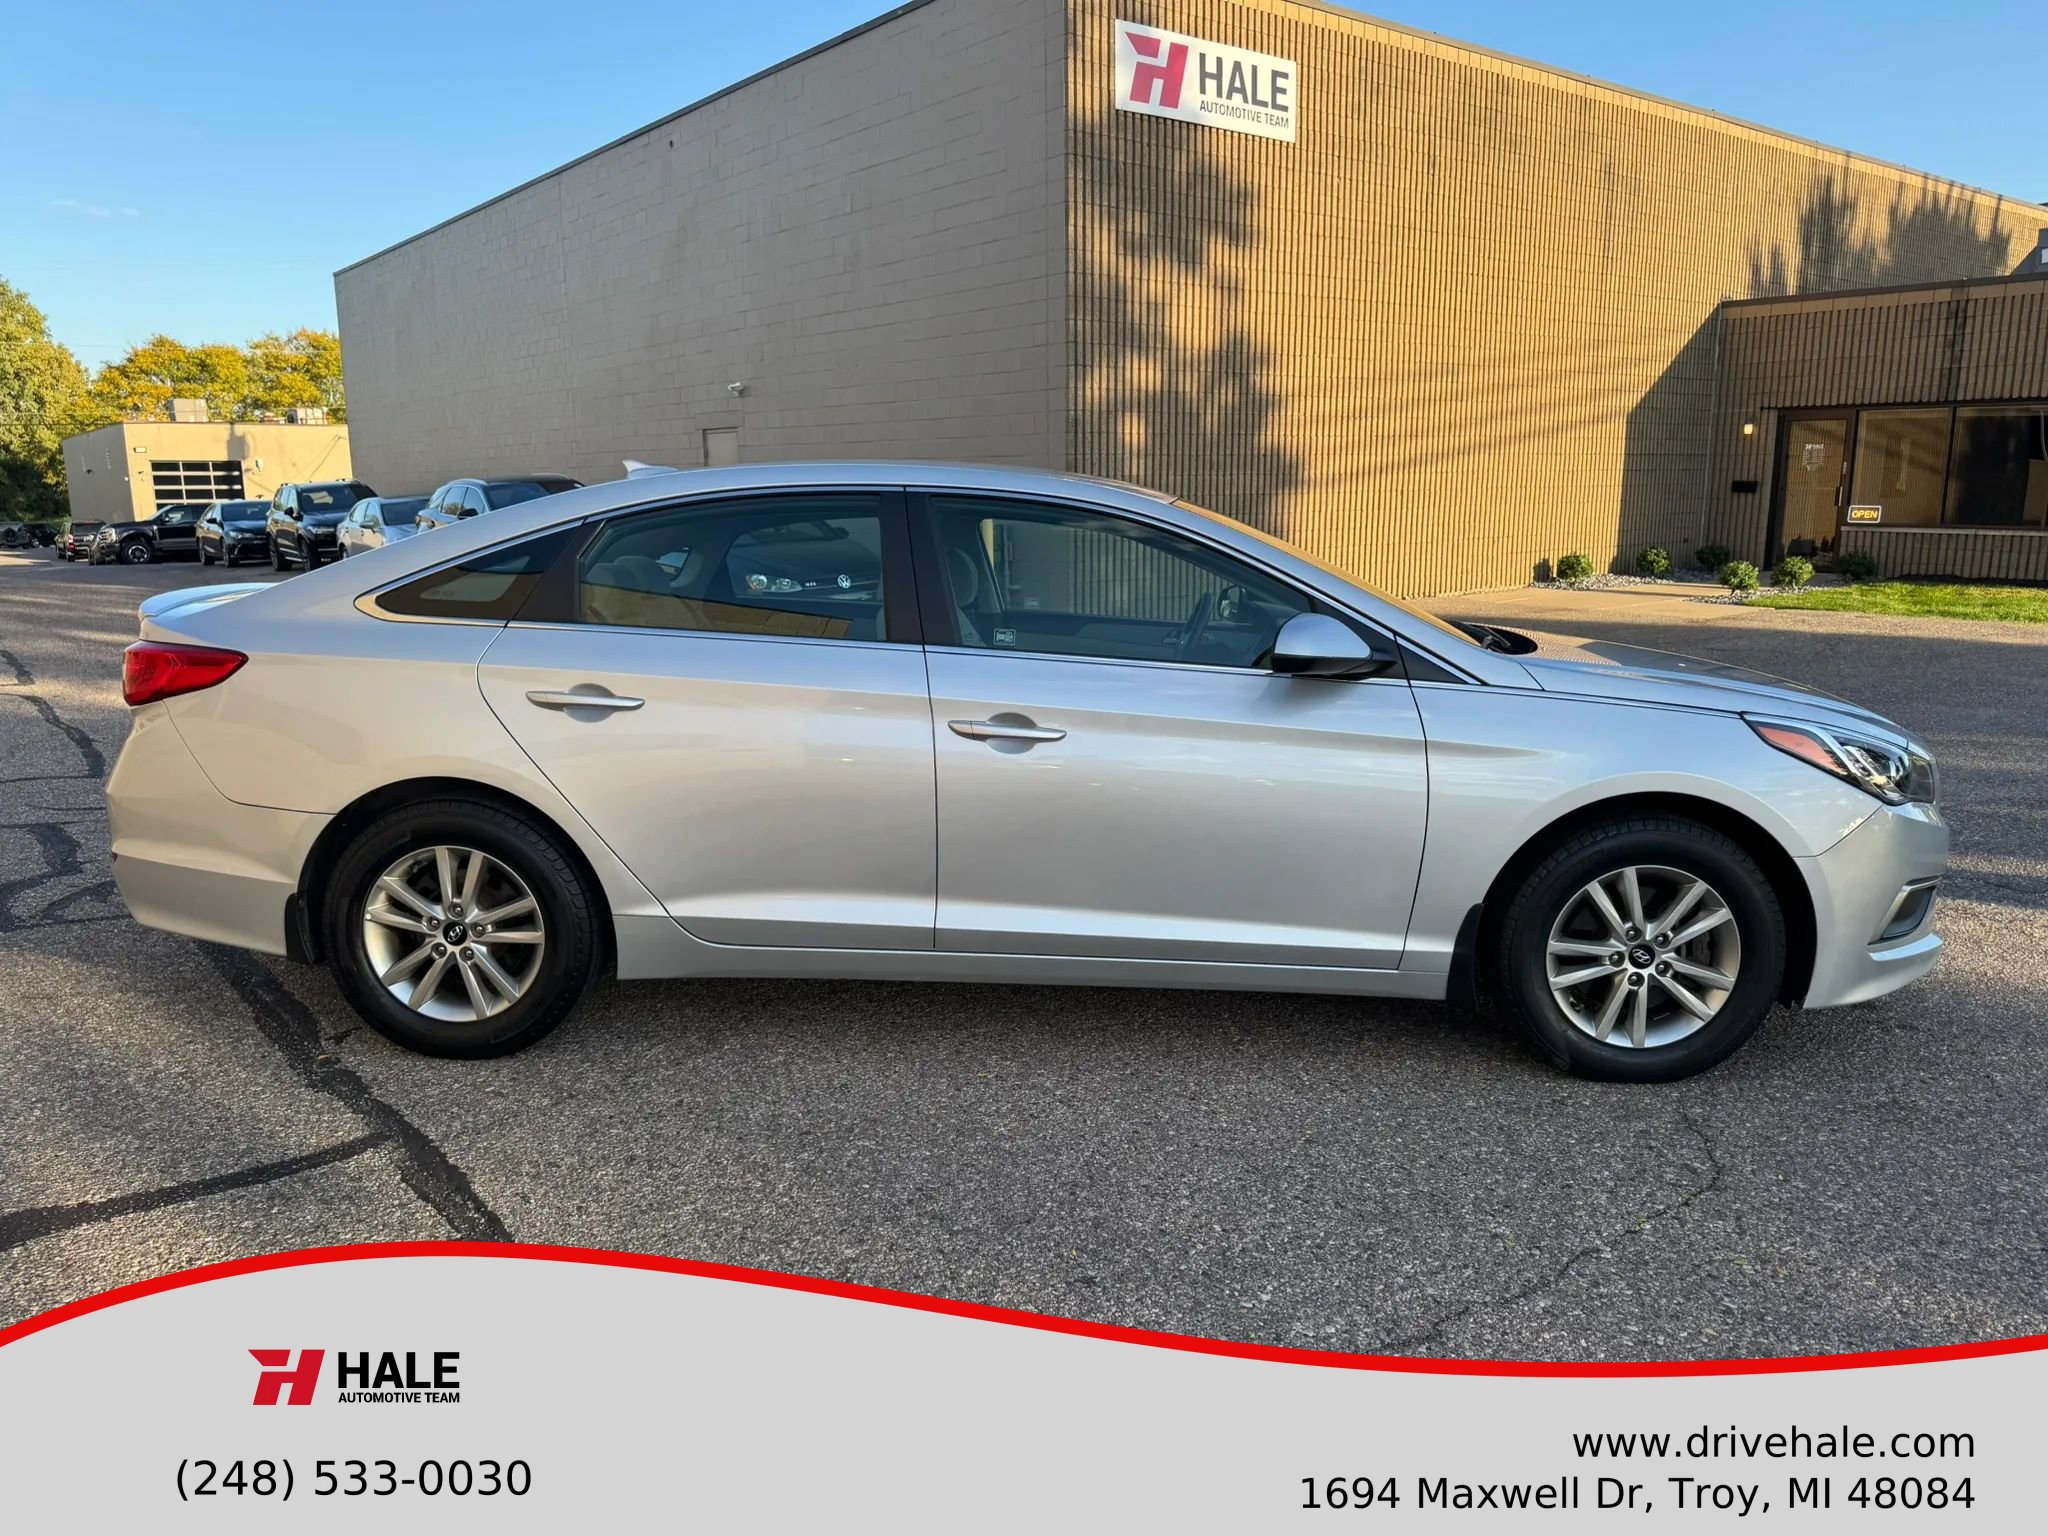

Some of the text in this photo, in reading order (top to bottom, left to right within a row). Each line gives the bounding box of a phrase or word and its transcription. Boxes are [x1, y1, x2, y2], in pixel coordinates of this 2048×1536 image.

[1199, 52, 1289, 113] HALE
[1199, 99, 1289, 129] AUTOMOTIVE TEAM
[1851, 510, 1878, 519] OPEN
